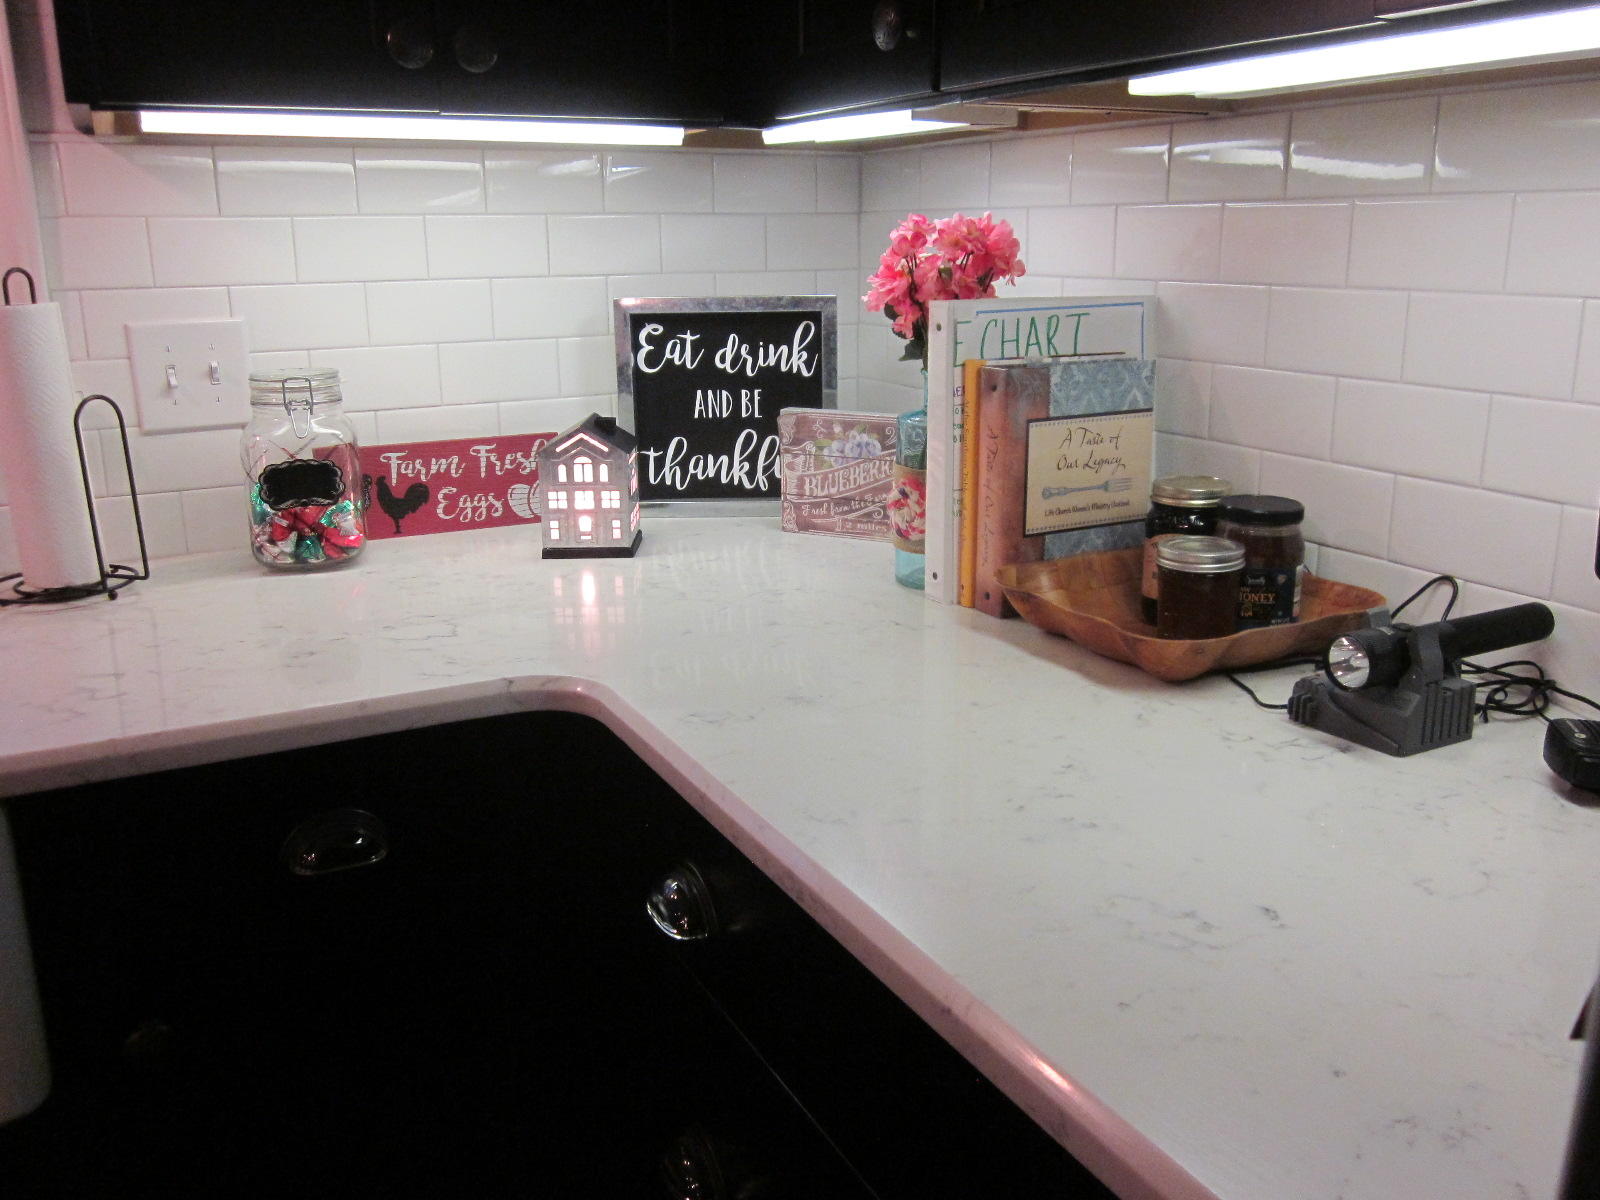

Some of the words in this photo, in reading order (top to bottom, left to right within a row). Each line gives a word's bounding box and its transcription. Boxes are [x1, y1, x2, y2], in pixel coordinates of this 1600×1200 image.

[636, 322, 705, 374] Eat
[714, 320, 819, 377] drink
[979, 312, 1090, 360] CHART
[693, 389, 733, 419] AND
[741, 389, 763, 418] BE
[1059, 427, 1073, 449] A
[1075, 426, 1104, 448] Taste
[1108, 427, 1122, 450] of
[379, 450, 466, 487] Farm
[1056, 454, 1080, 471] Our
[1083, 449, 1127, 475] Legacy
[436, 486, 505, 523] Eggs
